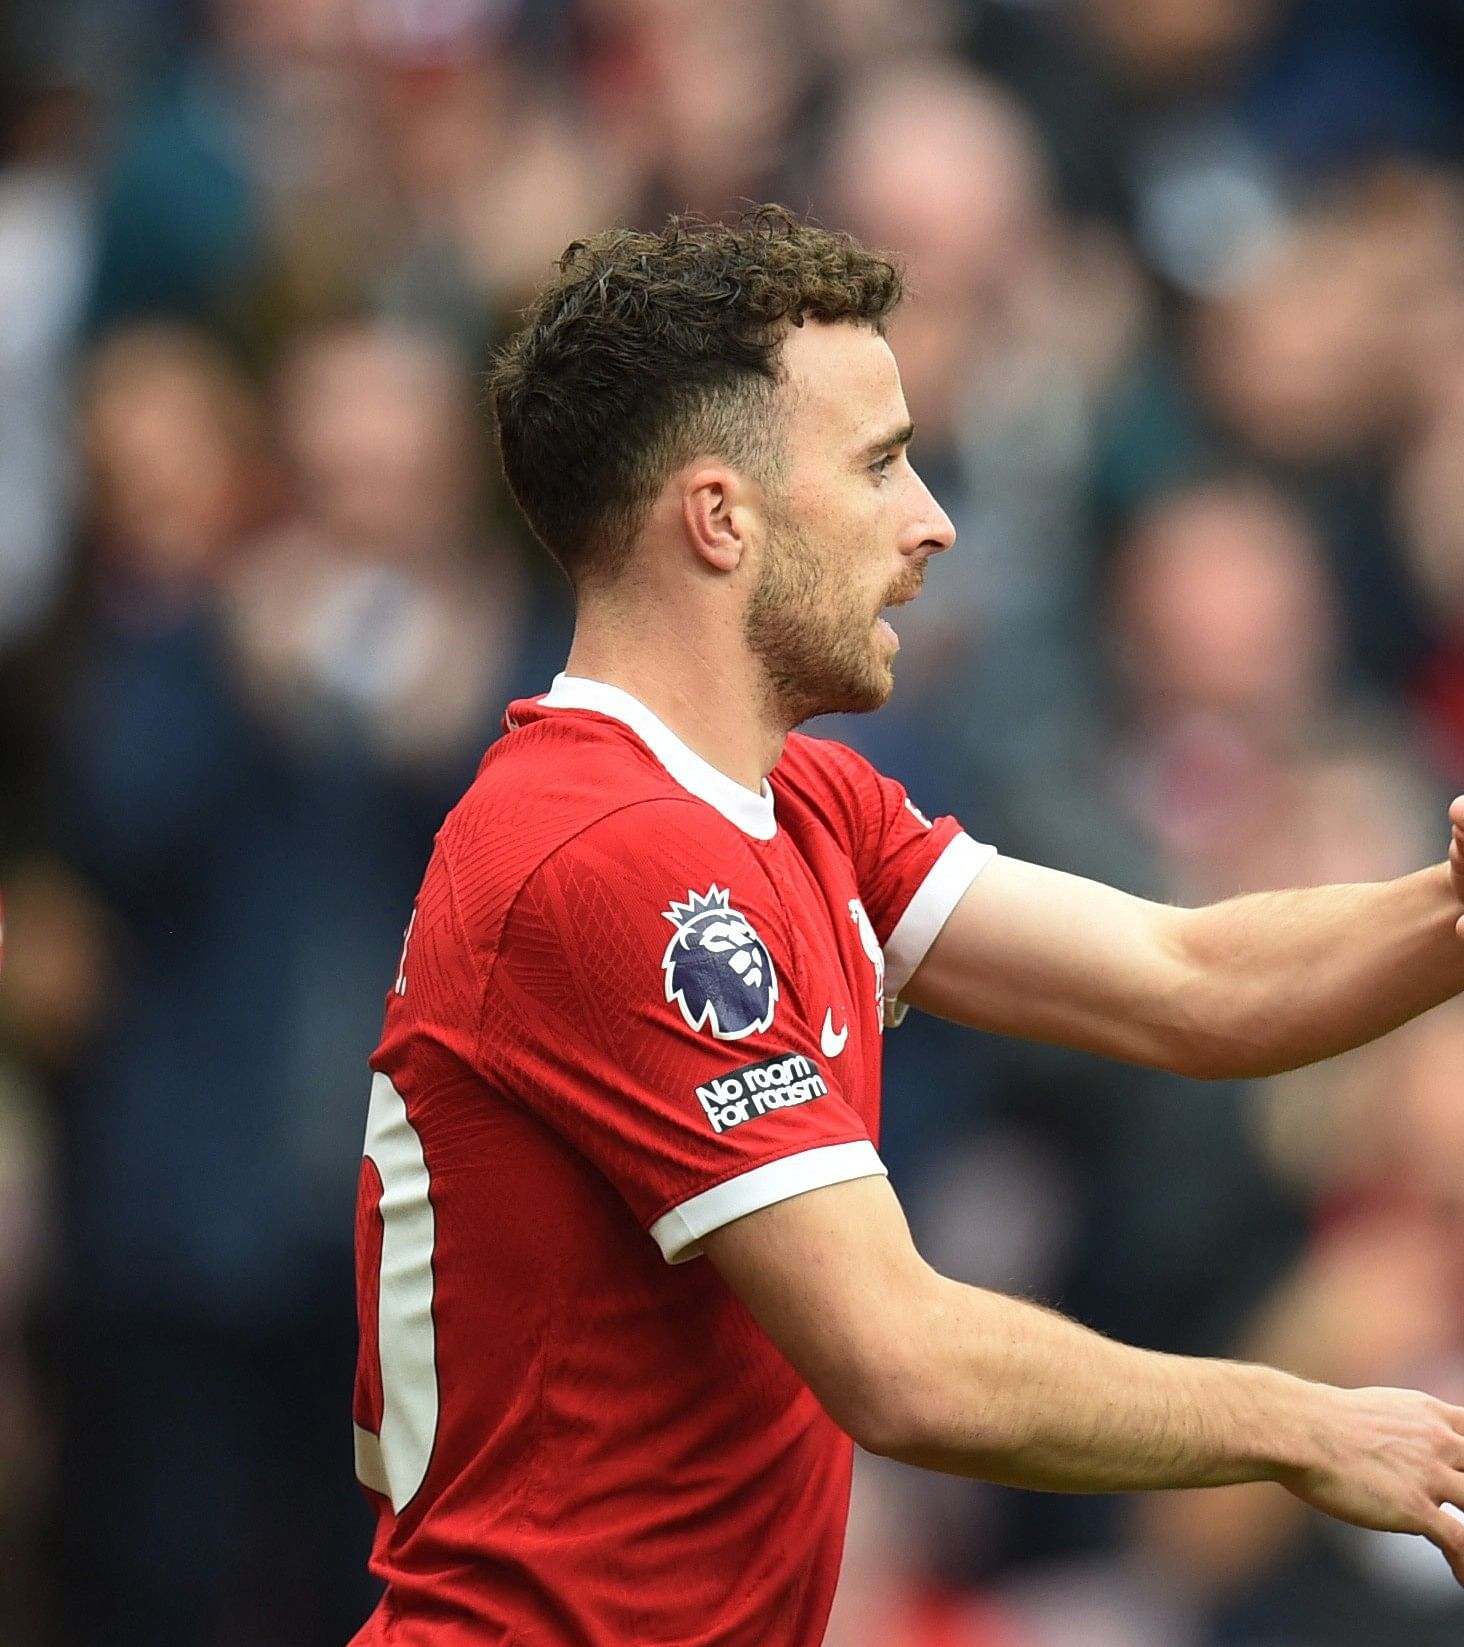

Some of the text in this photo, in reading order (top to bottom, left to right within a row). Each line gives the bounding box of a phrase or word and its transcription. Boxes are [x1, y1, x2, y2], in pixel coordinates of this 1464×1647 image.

[695, 1055, 811, 1113] No room
[707, 1074, 828, 1133] for racism
